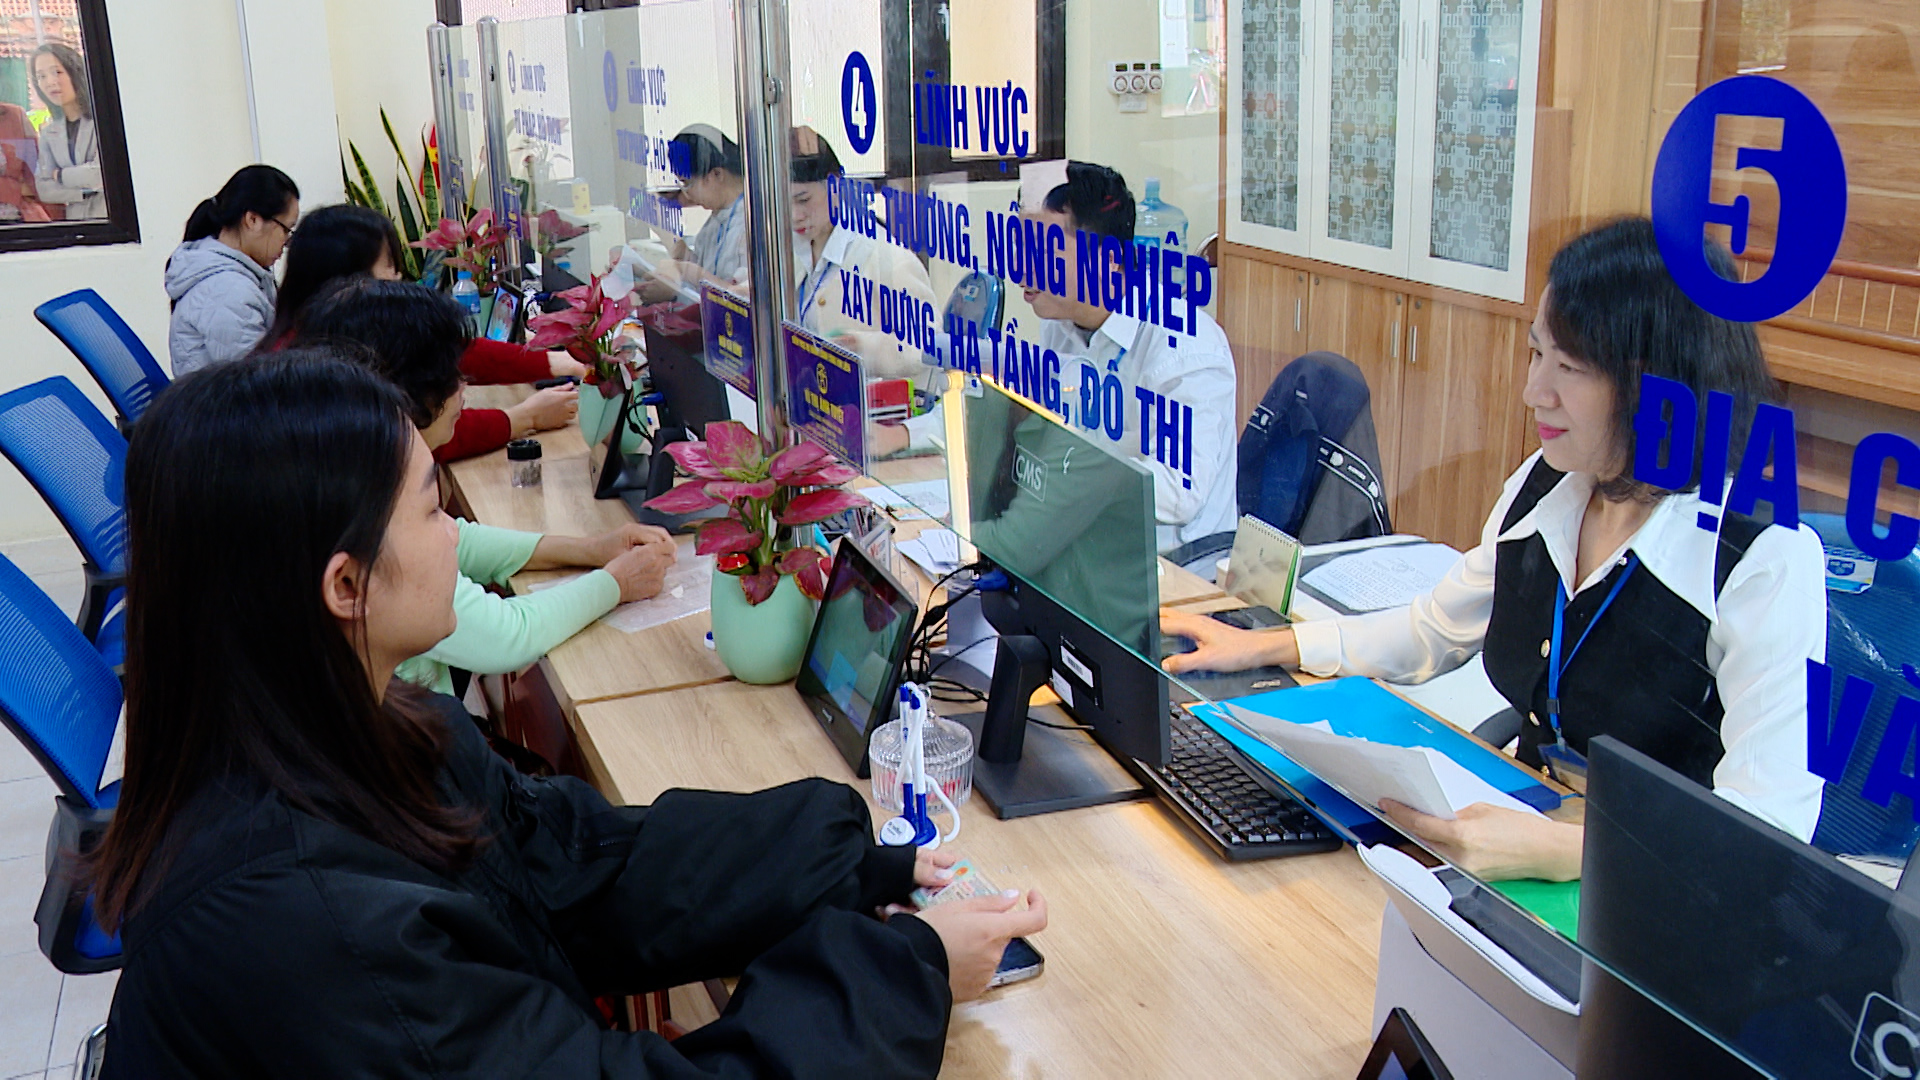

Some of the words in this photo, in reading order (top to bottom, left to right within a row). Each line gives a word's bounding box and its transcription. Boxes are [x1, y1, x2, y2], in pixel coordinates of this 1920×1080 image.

[626, 60, 647, 104] LĨNH
[647, 64, 667, 113] VỰC
[852, 67, 867, 140] 4
[914, 69, 968, 150] LĨNH
[975, 79, 1029, 173] VỰC
[652, 129, 666, 183] HỘ
[1703, 113, 1785, 284] 5
[827, 165, 877, 240] CÔNG
[881, 186, 979, 279] THƯƠNG,
[986, 201, 1066, 297] NÔNG
[1076, 231, 1212, 348] NGHIỆP
[840, 265, 874, 327] XÂY
[879, 287, 943, 368] DỰNG,
[949, 313, 982, 388] HẠ
[988, 317, 1069, 424] TẦNG,
[1080, 359, 1124, 442] ĐÔ
[1136, 386, 1193, 490] THỊ
[1016, 455, 1042, 491] CMS
[1633, 373, 1800, 532] ĐỊA
[1873, 1021, 1920, 1080] C
